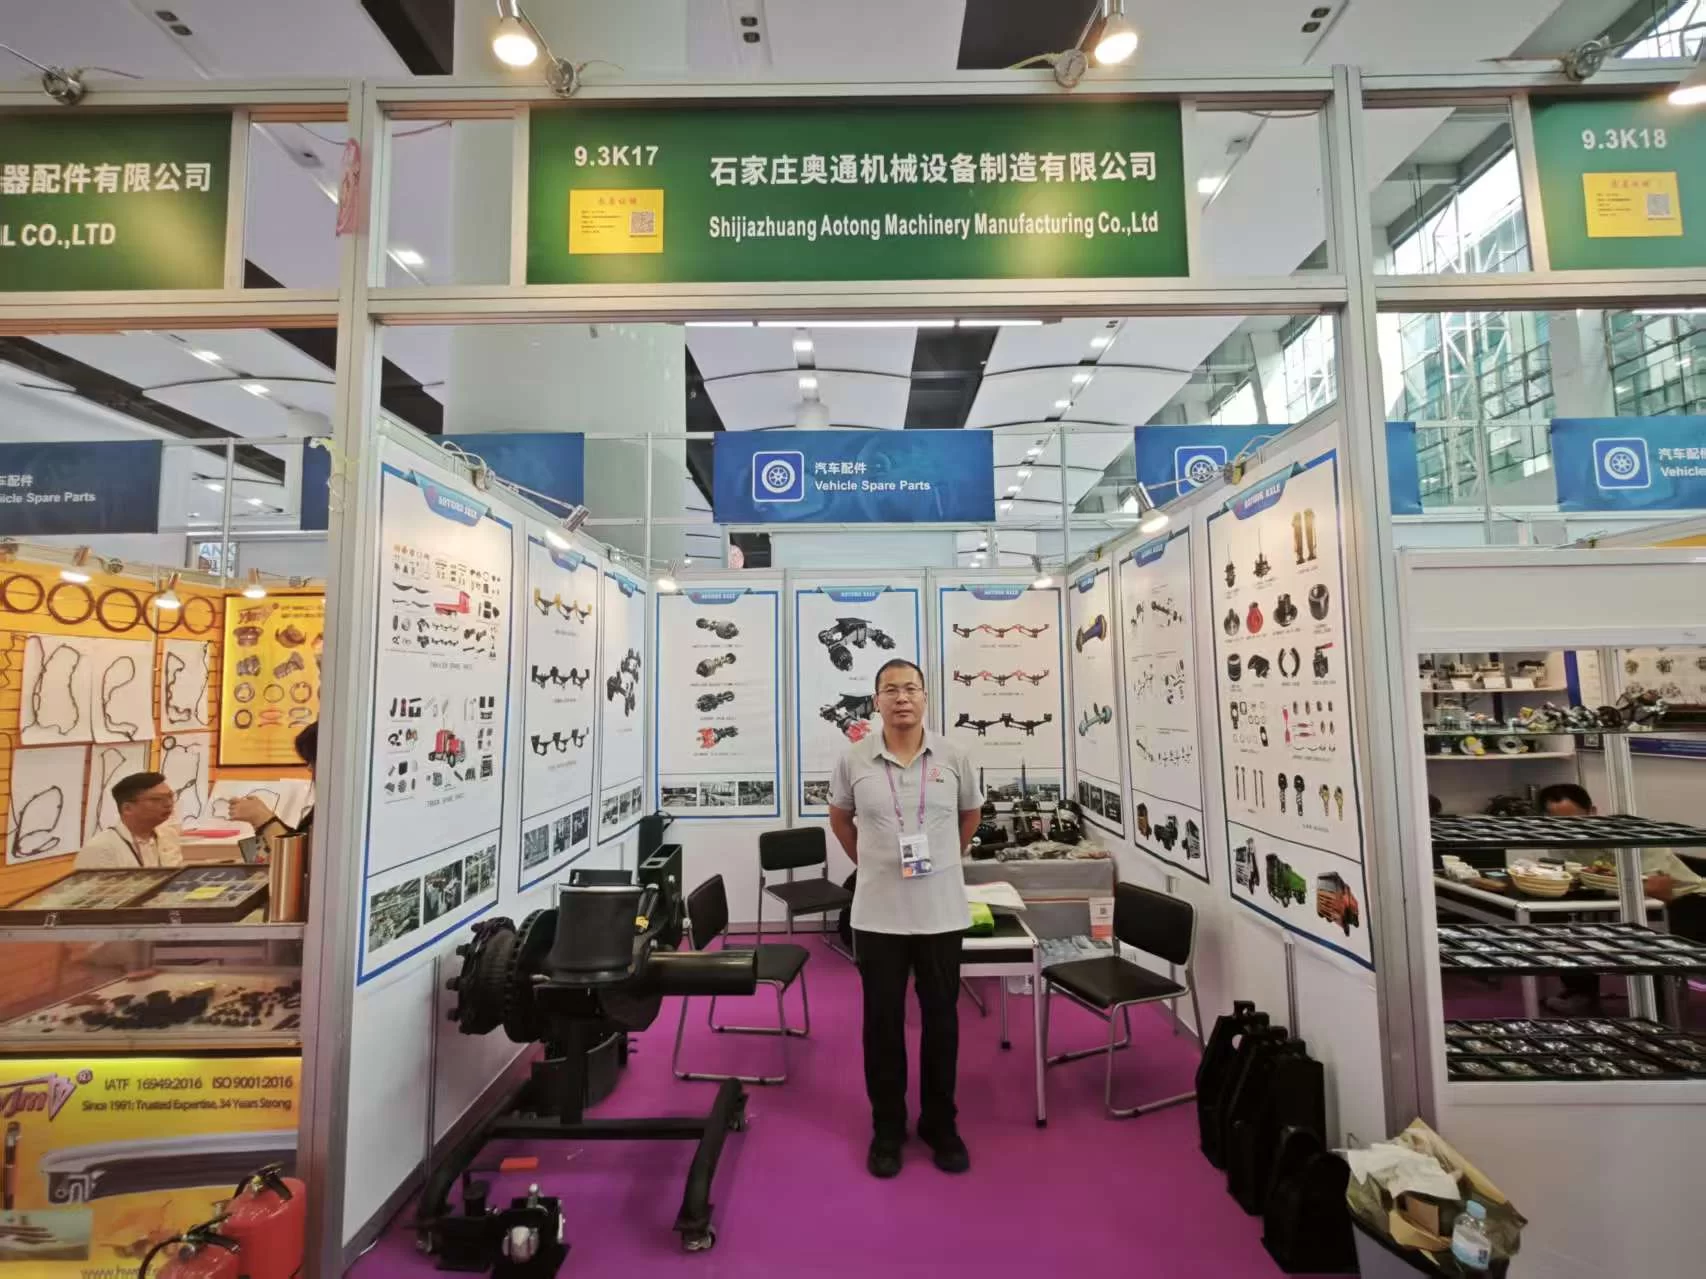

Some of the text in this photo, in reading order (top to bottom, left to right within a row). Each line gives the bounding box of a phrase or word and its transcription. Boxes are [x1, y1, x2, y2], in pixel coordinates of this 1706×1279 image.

[1581, 128, 1668, 149] 9.3K18
[574, 145, 659, 167] 9.3K17
[710, 151, 1157, 186] 石家庄奥通机械设备制造有限公司
[709, 211, 1159, 242] Shijiazhuang Aotong Machinery Manufacturing Co.,Ltd
[0, 223, 116, 249] L CO.,LTD
[815, 462, 867, 474] 汽车配件
[815, 480, 931, 492] Vehicle Spare Parts
[26, 493, 61, 505] Spare
[64, 492, 96, 502] Parts
[104, 1078, 130, 1091] IATF
[212, 1076, 232, 1089] ISO
[233, 1075, 293, 1089] 9001:2016
[82, 1101, 107, 1111] Since
[136, 1100, 171, 1111] Trusted
[220, 1099, 230, 1109] 34
[231, 1099, 258, 1109] Years
[259, 1098, 292, 1111] Strong
